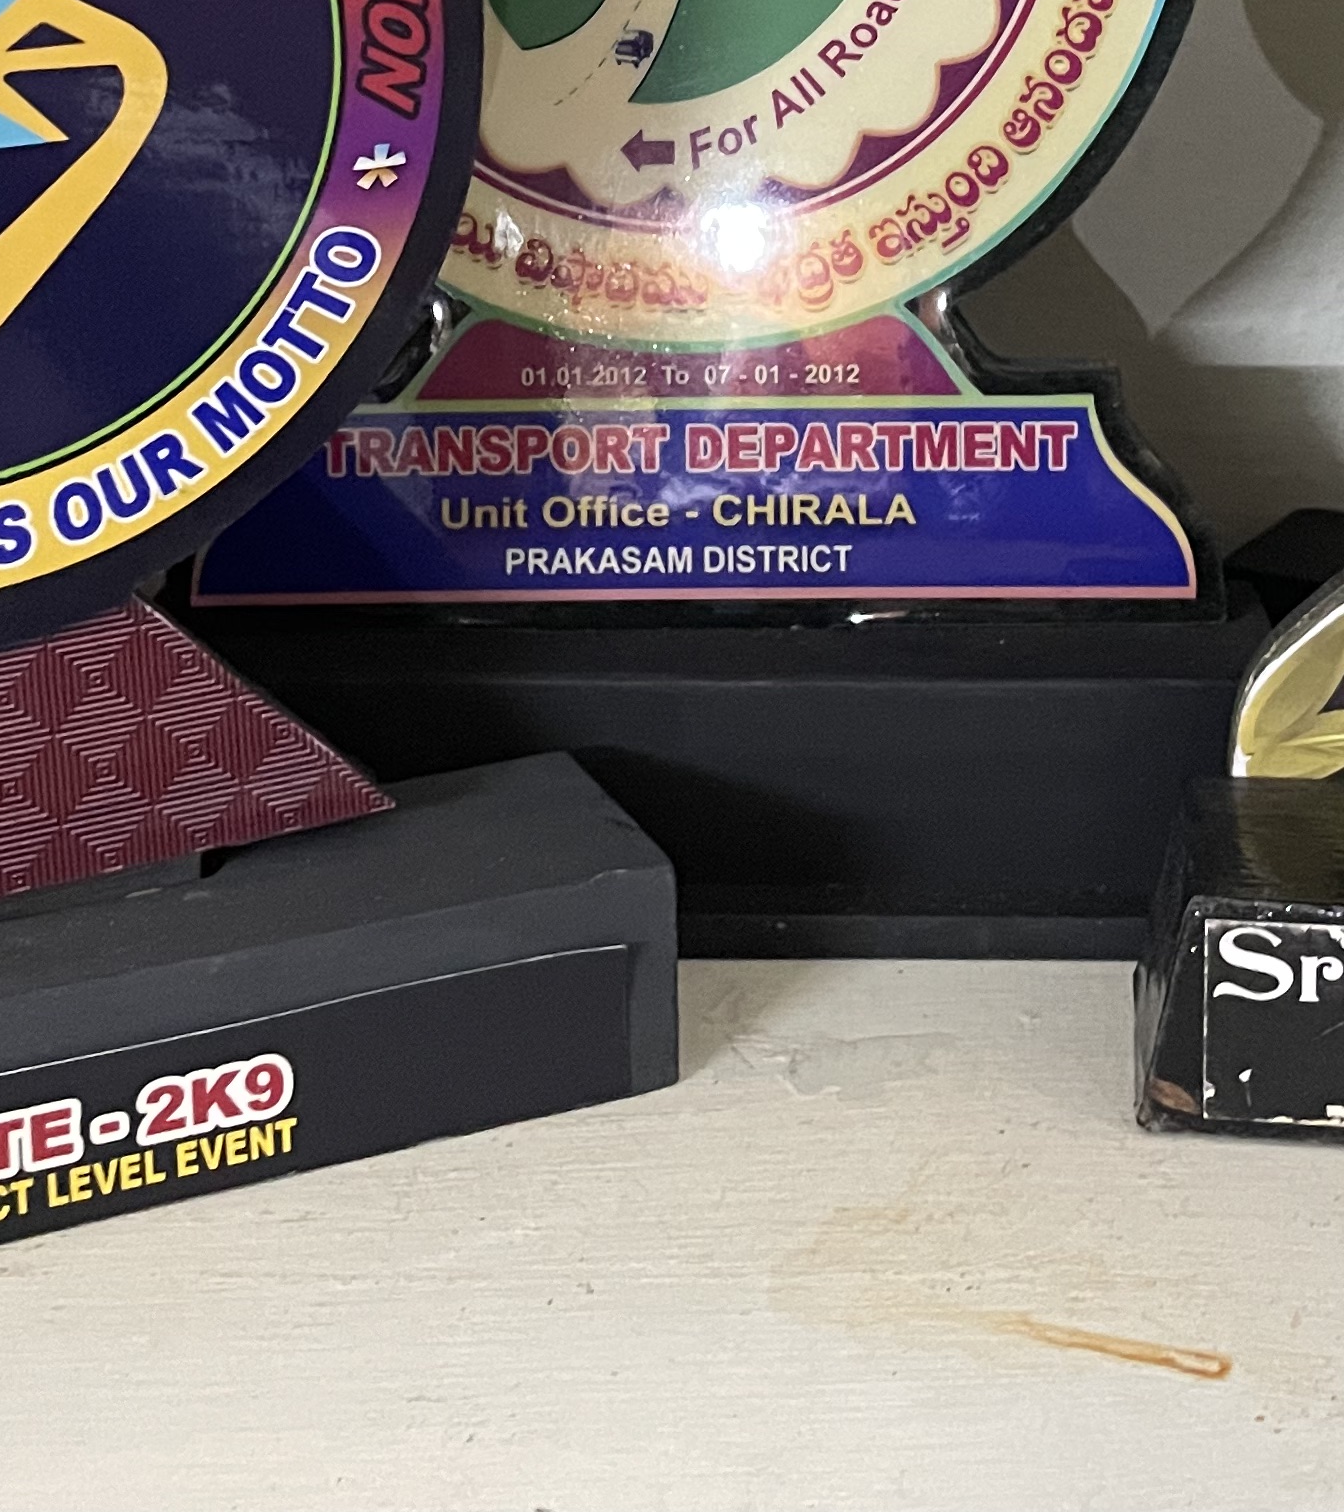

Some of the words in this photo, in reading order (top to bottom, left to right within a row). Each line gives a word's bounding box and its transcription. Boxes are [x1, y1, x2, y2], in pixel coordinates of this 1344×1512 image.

[690, 114, 757, 169] For
[771, 67, 826, 129] All
[52, 430, 198, 545] OUR
[205, 225, 384, 455] MOTTO
[661, 365, 689, 385] To
[324, 422, 668, 479] TRANSPORT
[685, 420, 1079, 474] DEPARTMENT
[440, 496, 529, 531] Unit
[542, 494, 670, 528] Office
[712, 494, 917, 527] CHIRALA
[504, 548, 694, 576] PRAKASAM
[701, 544, 853, 573] DISTRICT
[137, 1053, 293, 1145] 2K9
[48, 1149, 166, 1208] LEVEL
[176, 1118, 298, 1177] EVENT
